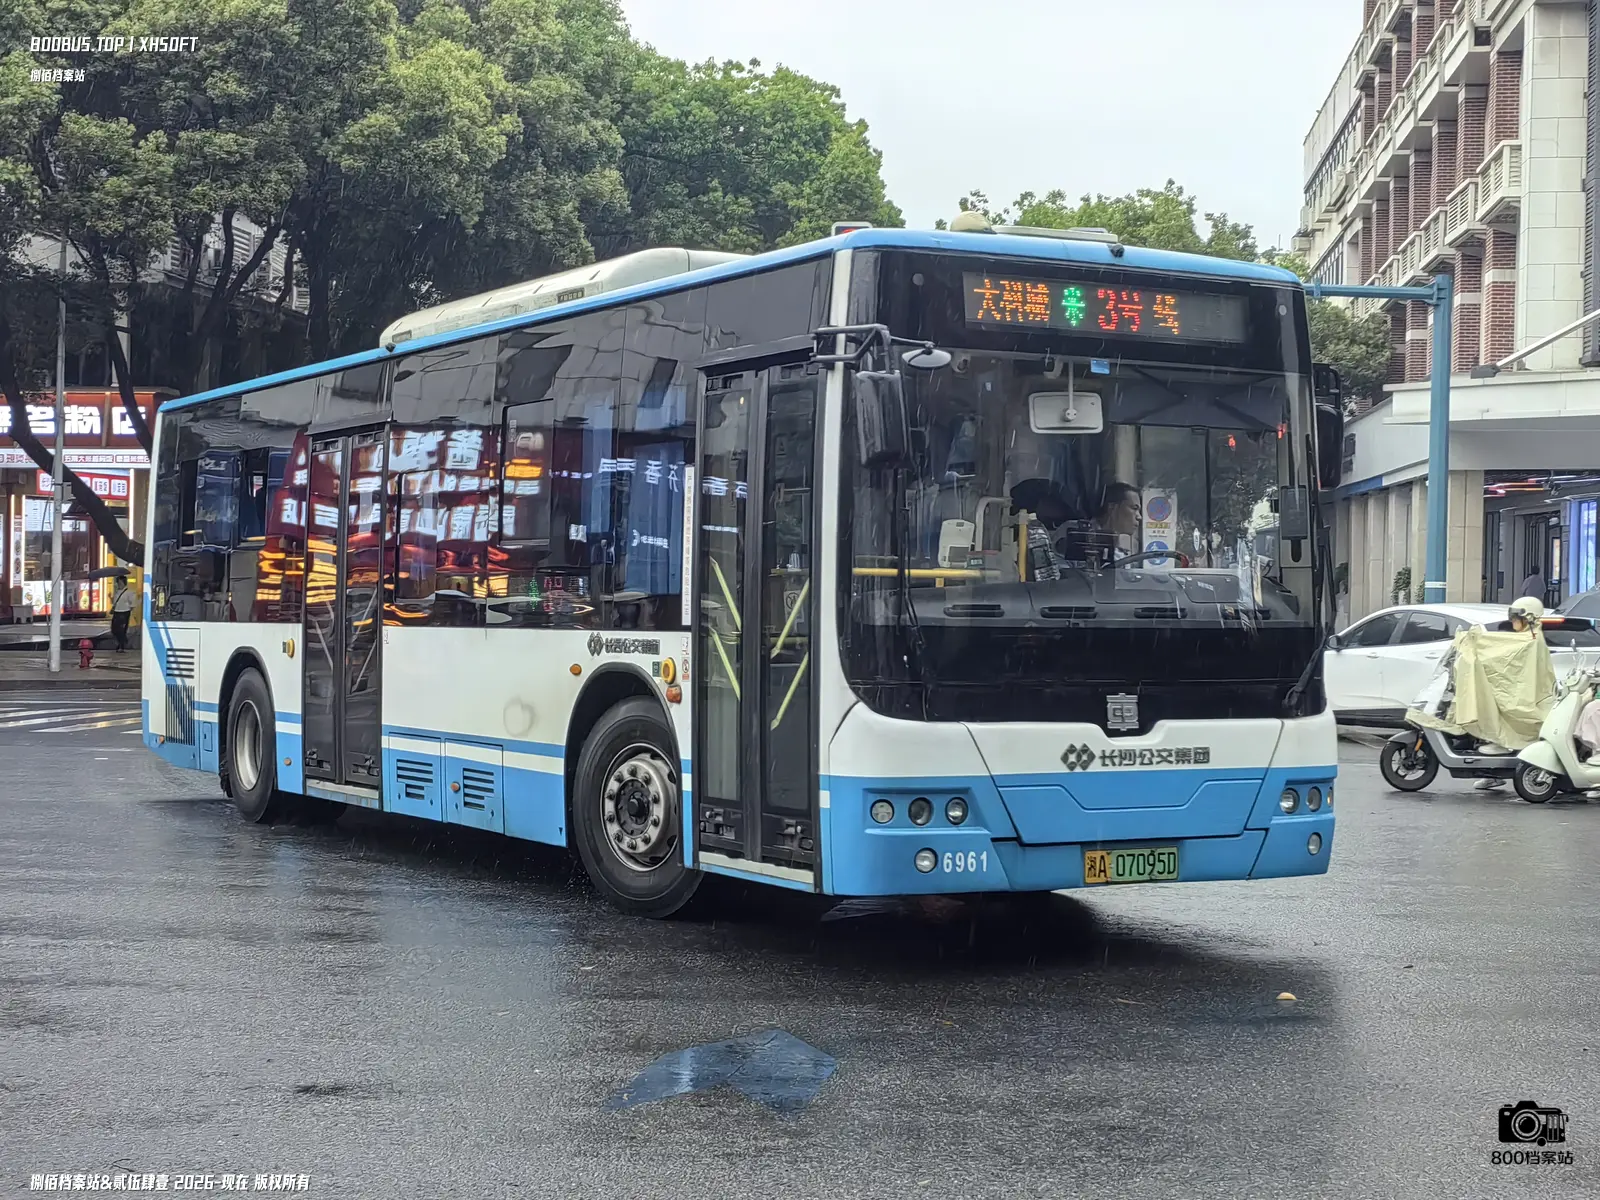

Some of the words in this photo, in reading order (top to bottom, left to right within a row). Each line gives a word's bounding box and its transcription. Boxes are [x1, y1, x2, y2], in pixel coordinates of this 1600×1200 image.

[1099, 747, 1211, 767] 长沙公交集团
[943, 851, 988, 873] 6961
